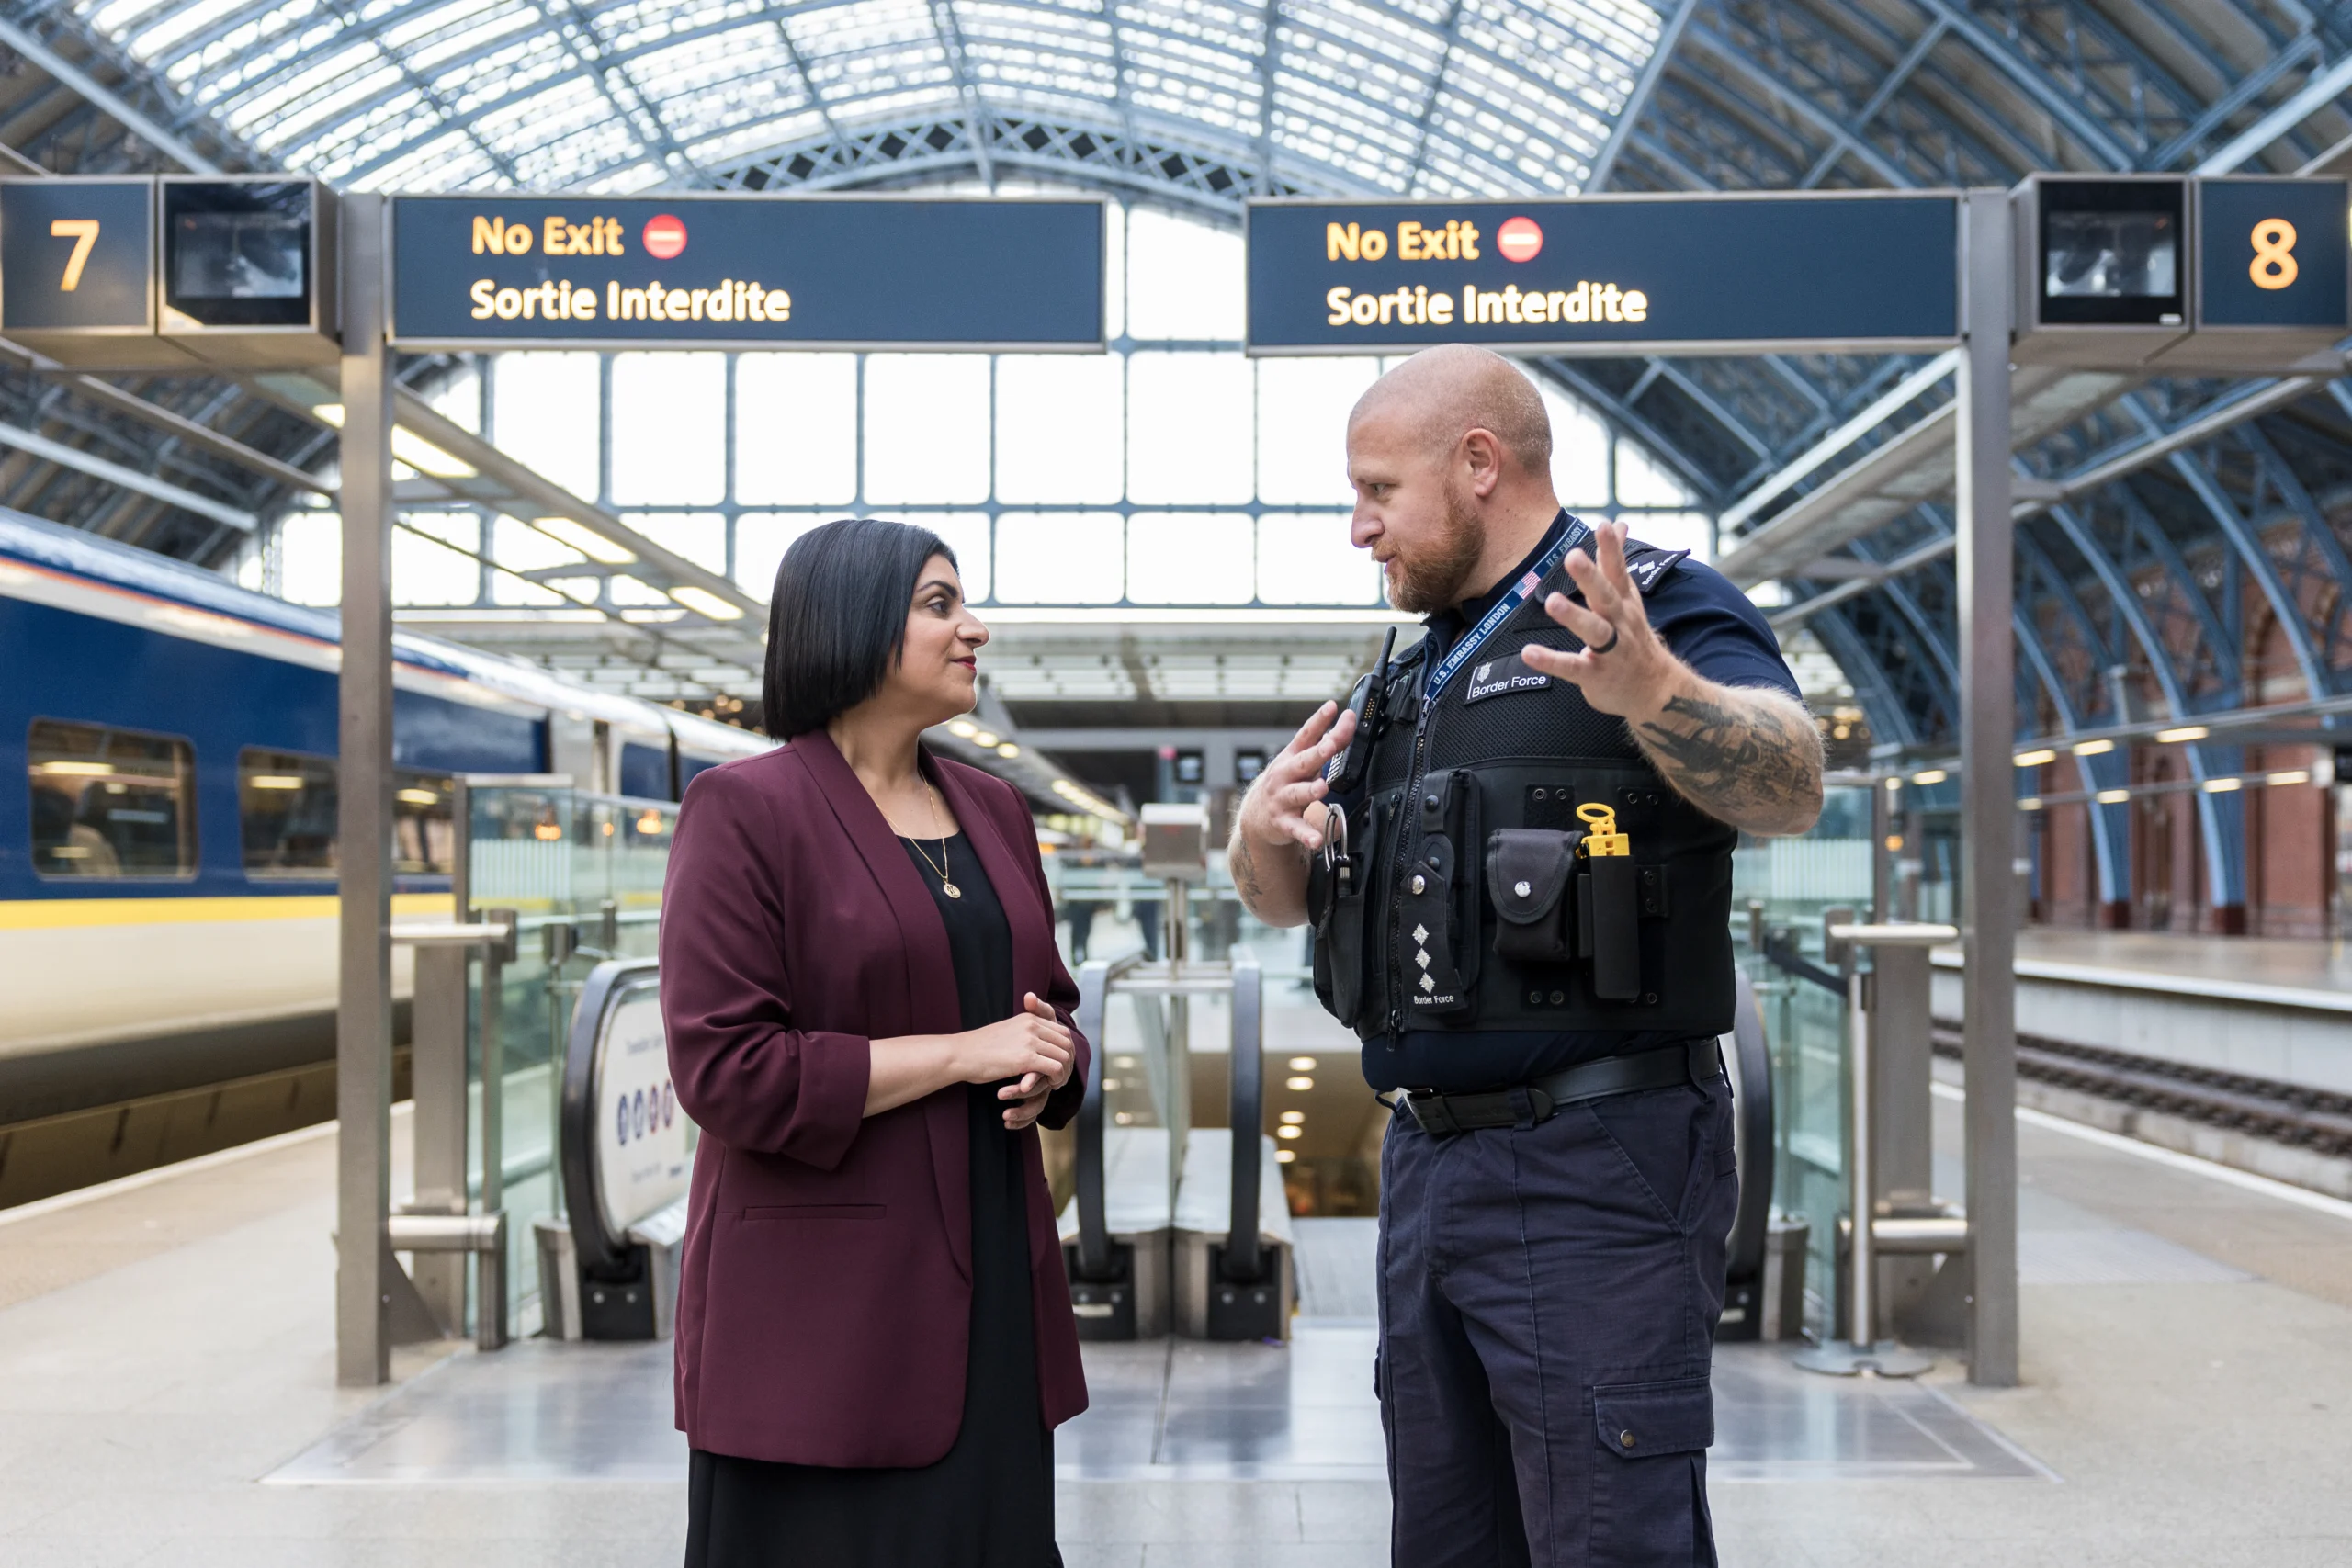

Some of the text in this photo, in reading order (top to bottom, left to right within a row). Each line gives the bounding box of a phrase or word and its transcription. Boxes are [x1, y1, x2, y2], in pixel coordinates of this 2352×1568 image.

[51, 220, 100, 291] 7
[472, 215, 625, 256] No Exit
[1327, 220, 1480, 261] No Exit
[2249, 218, 2299, 290] 8
[470, 278, 791, 321] Sortie Interdite
[1327, 280, 1648, 325] Sortie Interdite
[1559, 525, 1583, 554] EMBASSY
[1433, 603, 1510, 685] U.S. EMBASSY LONDON
[1472, 675, 1546, 698] Border Force
[1414, 995, 1454, 1005] Border Force
